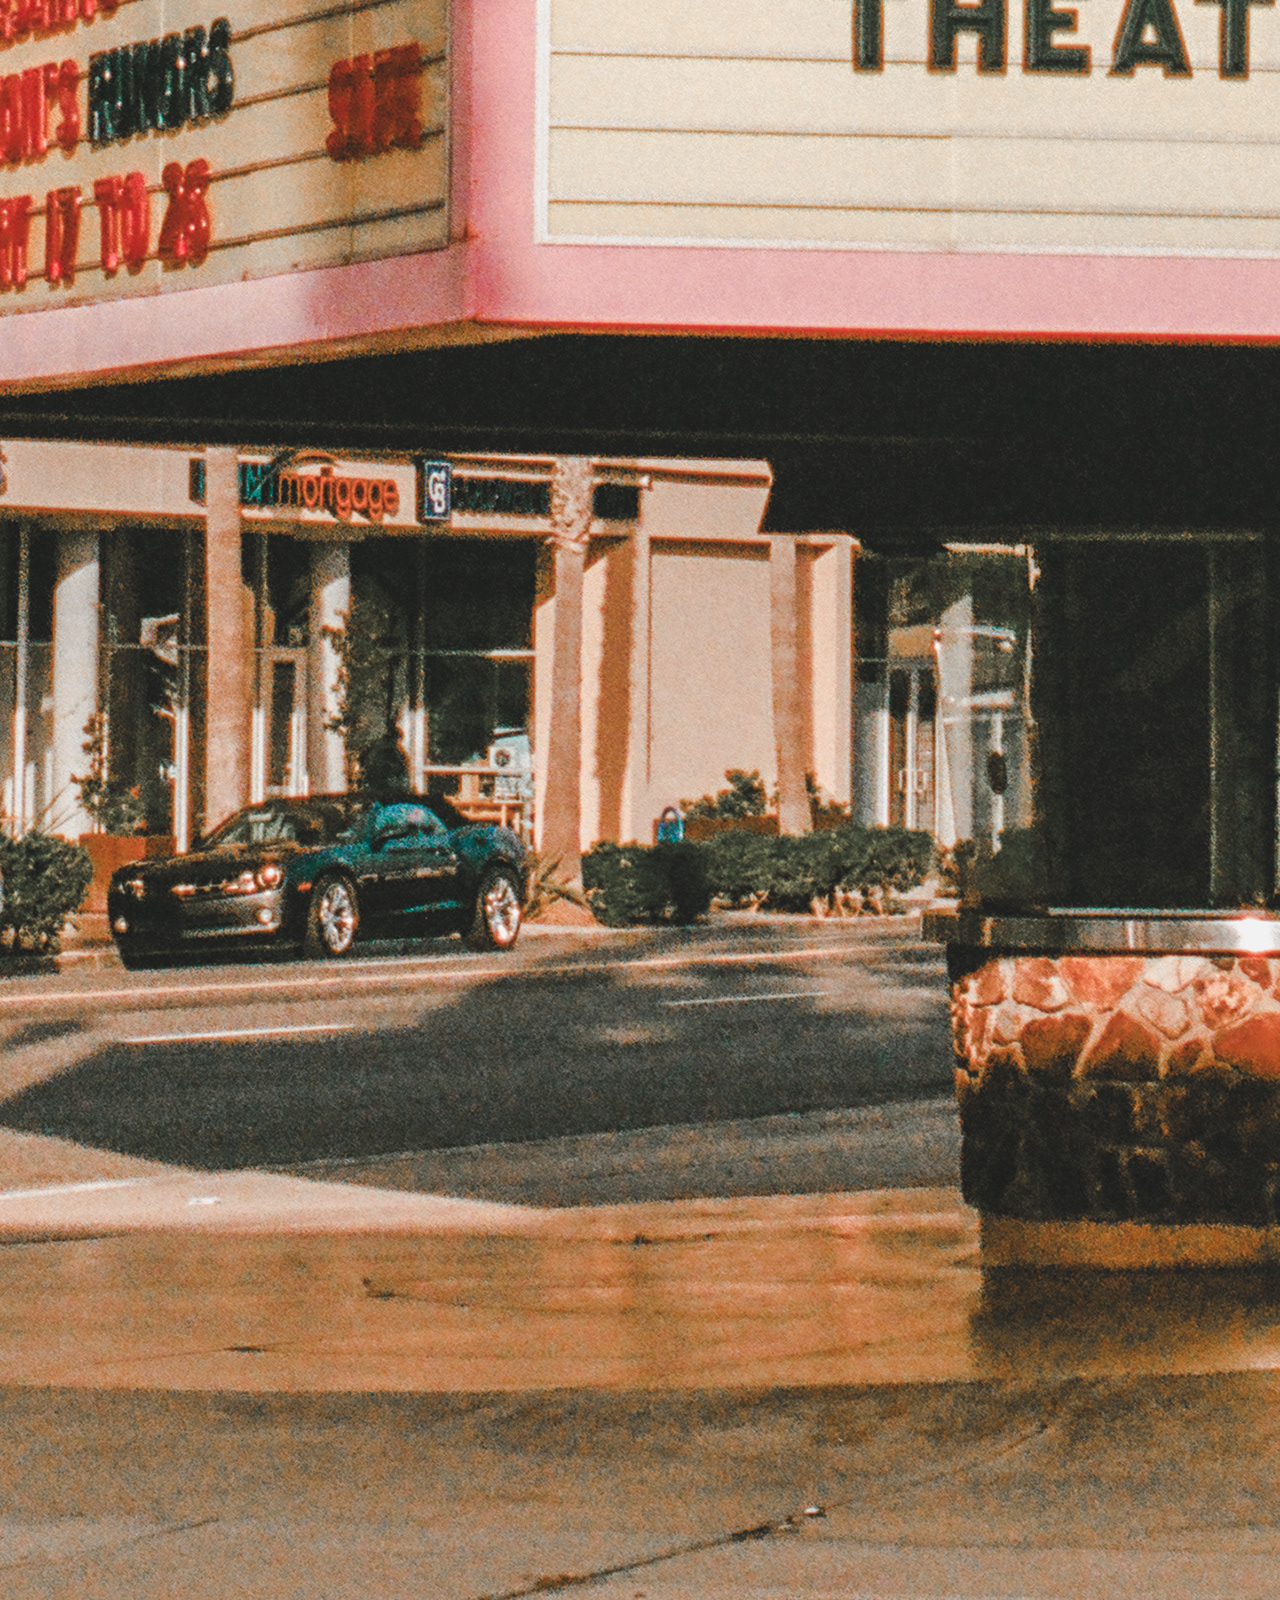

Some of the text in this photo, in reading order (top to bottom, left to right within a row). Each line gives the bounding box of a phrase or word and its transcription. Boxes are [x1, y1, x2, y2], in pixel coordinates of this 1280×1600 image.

[88, 16, 234, 151] RUMORS
[45, 186, 82, 288] 17
[93, 171, 150, 277] TO
[279, 467, 399, 521] mortgage
